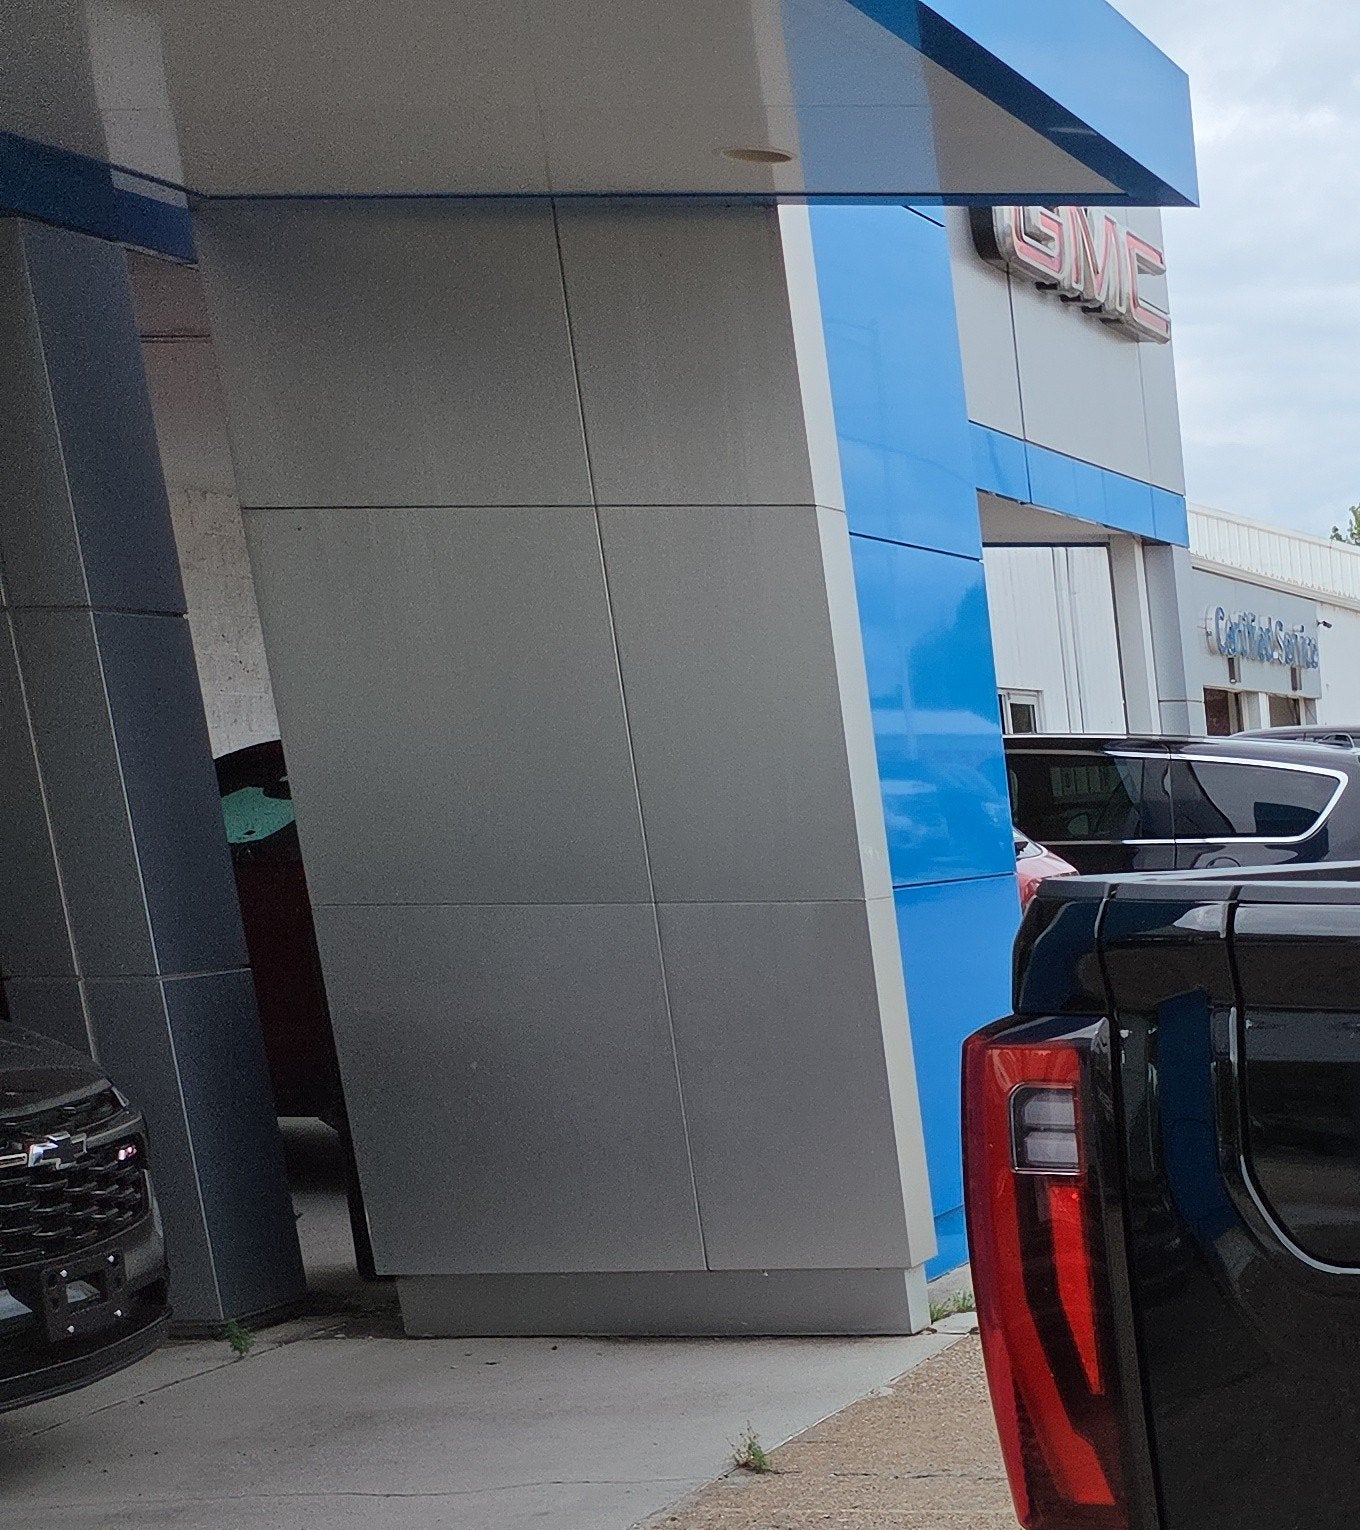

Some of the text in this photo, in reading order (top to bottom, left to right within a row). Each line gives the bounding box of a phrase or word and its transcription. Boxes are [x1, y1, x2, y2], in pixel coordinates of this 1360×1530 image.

[990, 206, 1172, 344] GMC
[1212, 605, 1319, 669] Certified Service
